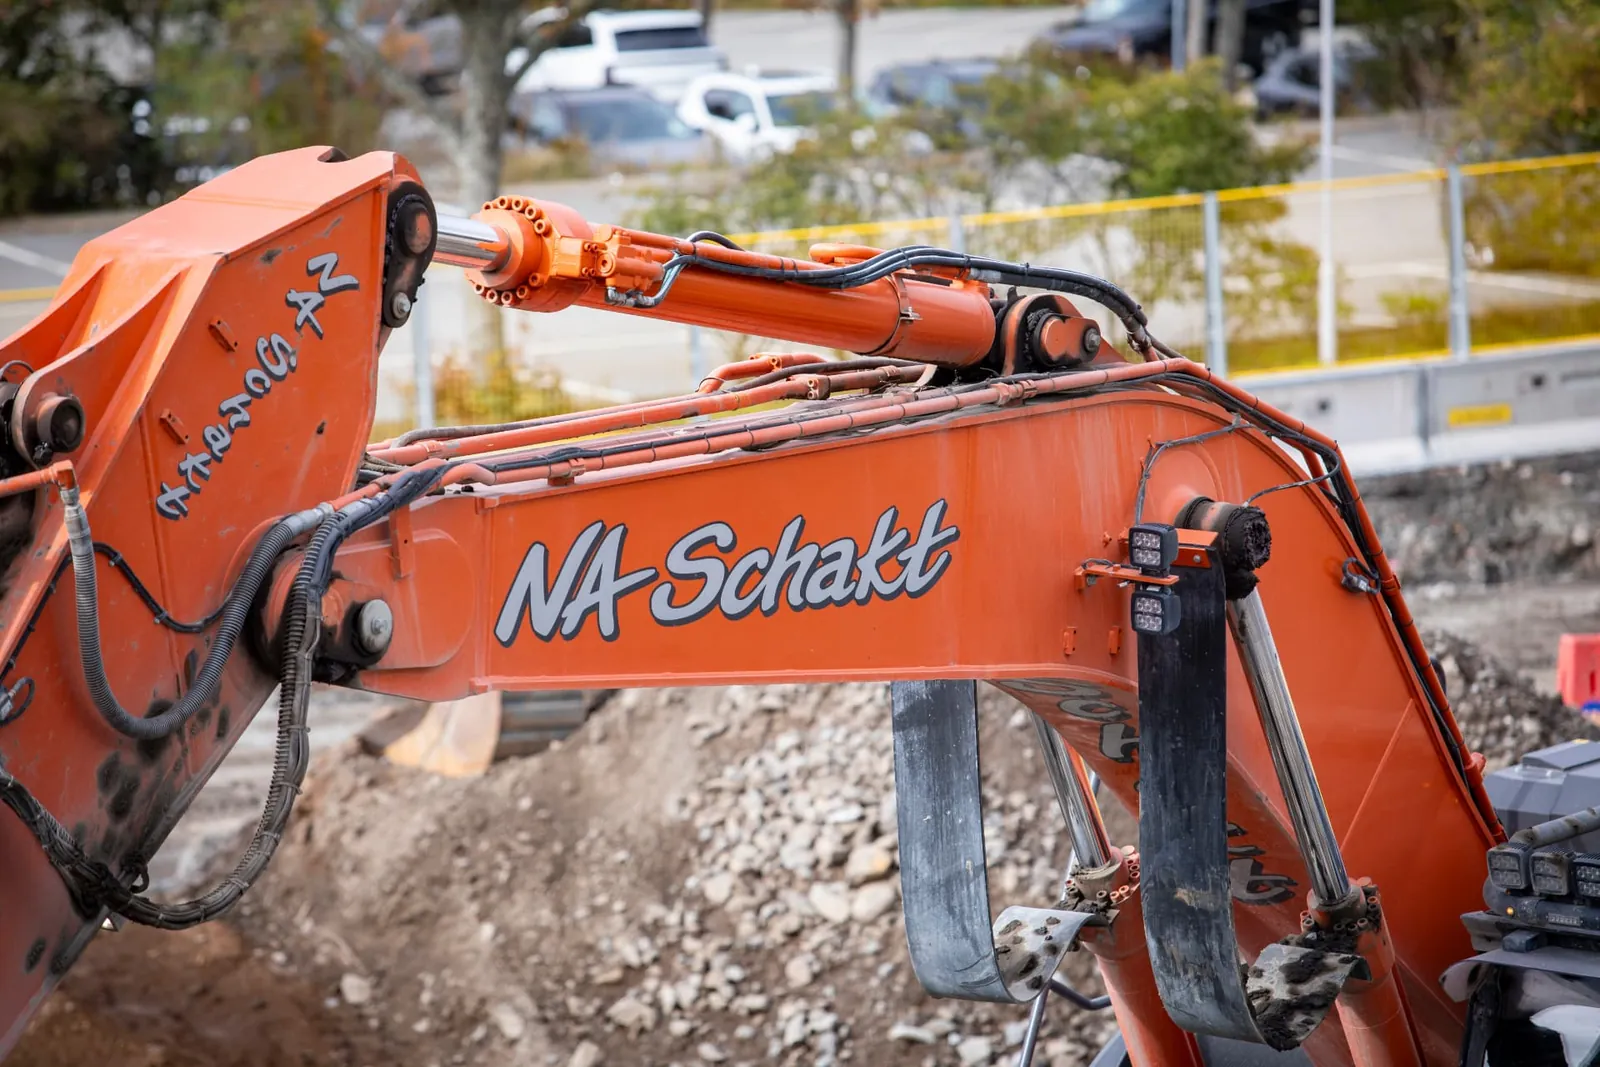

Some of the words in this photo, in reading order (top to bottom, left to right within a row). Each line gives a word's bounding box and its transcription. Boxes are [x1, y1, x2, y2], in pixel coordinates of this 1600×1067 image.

[285, 252, 360, 341] NA
[156, 333, 297, 521] Schakt
[494, 519, 659, 648] NA
[649, 498, 960, 627] Schakt
